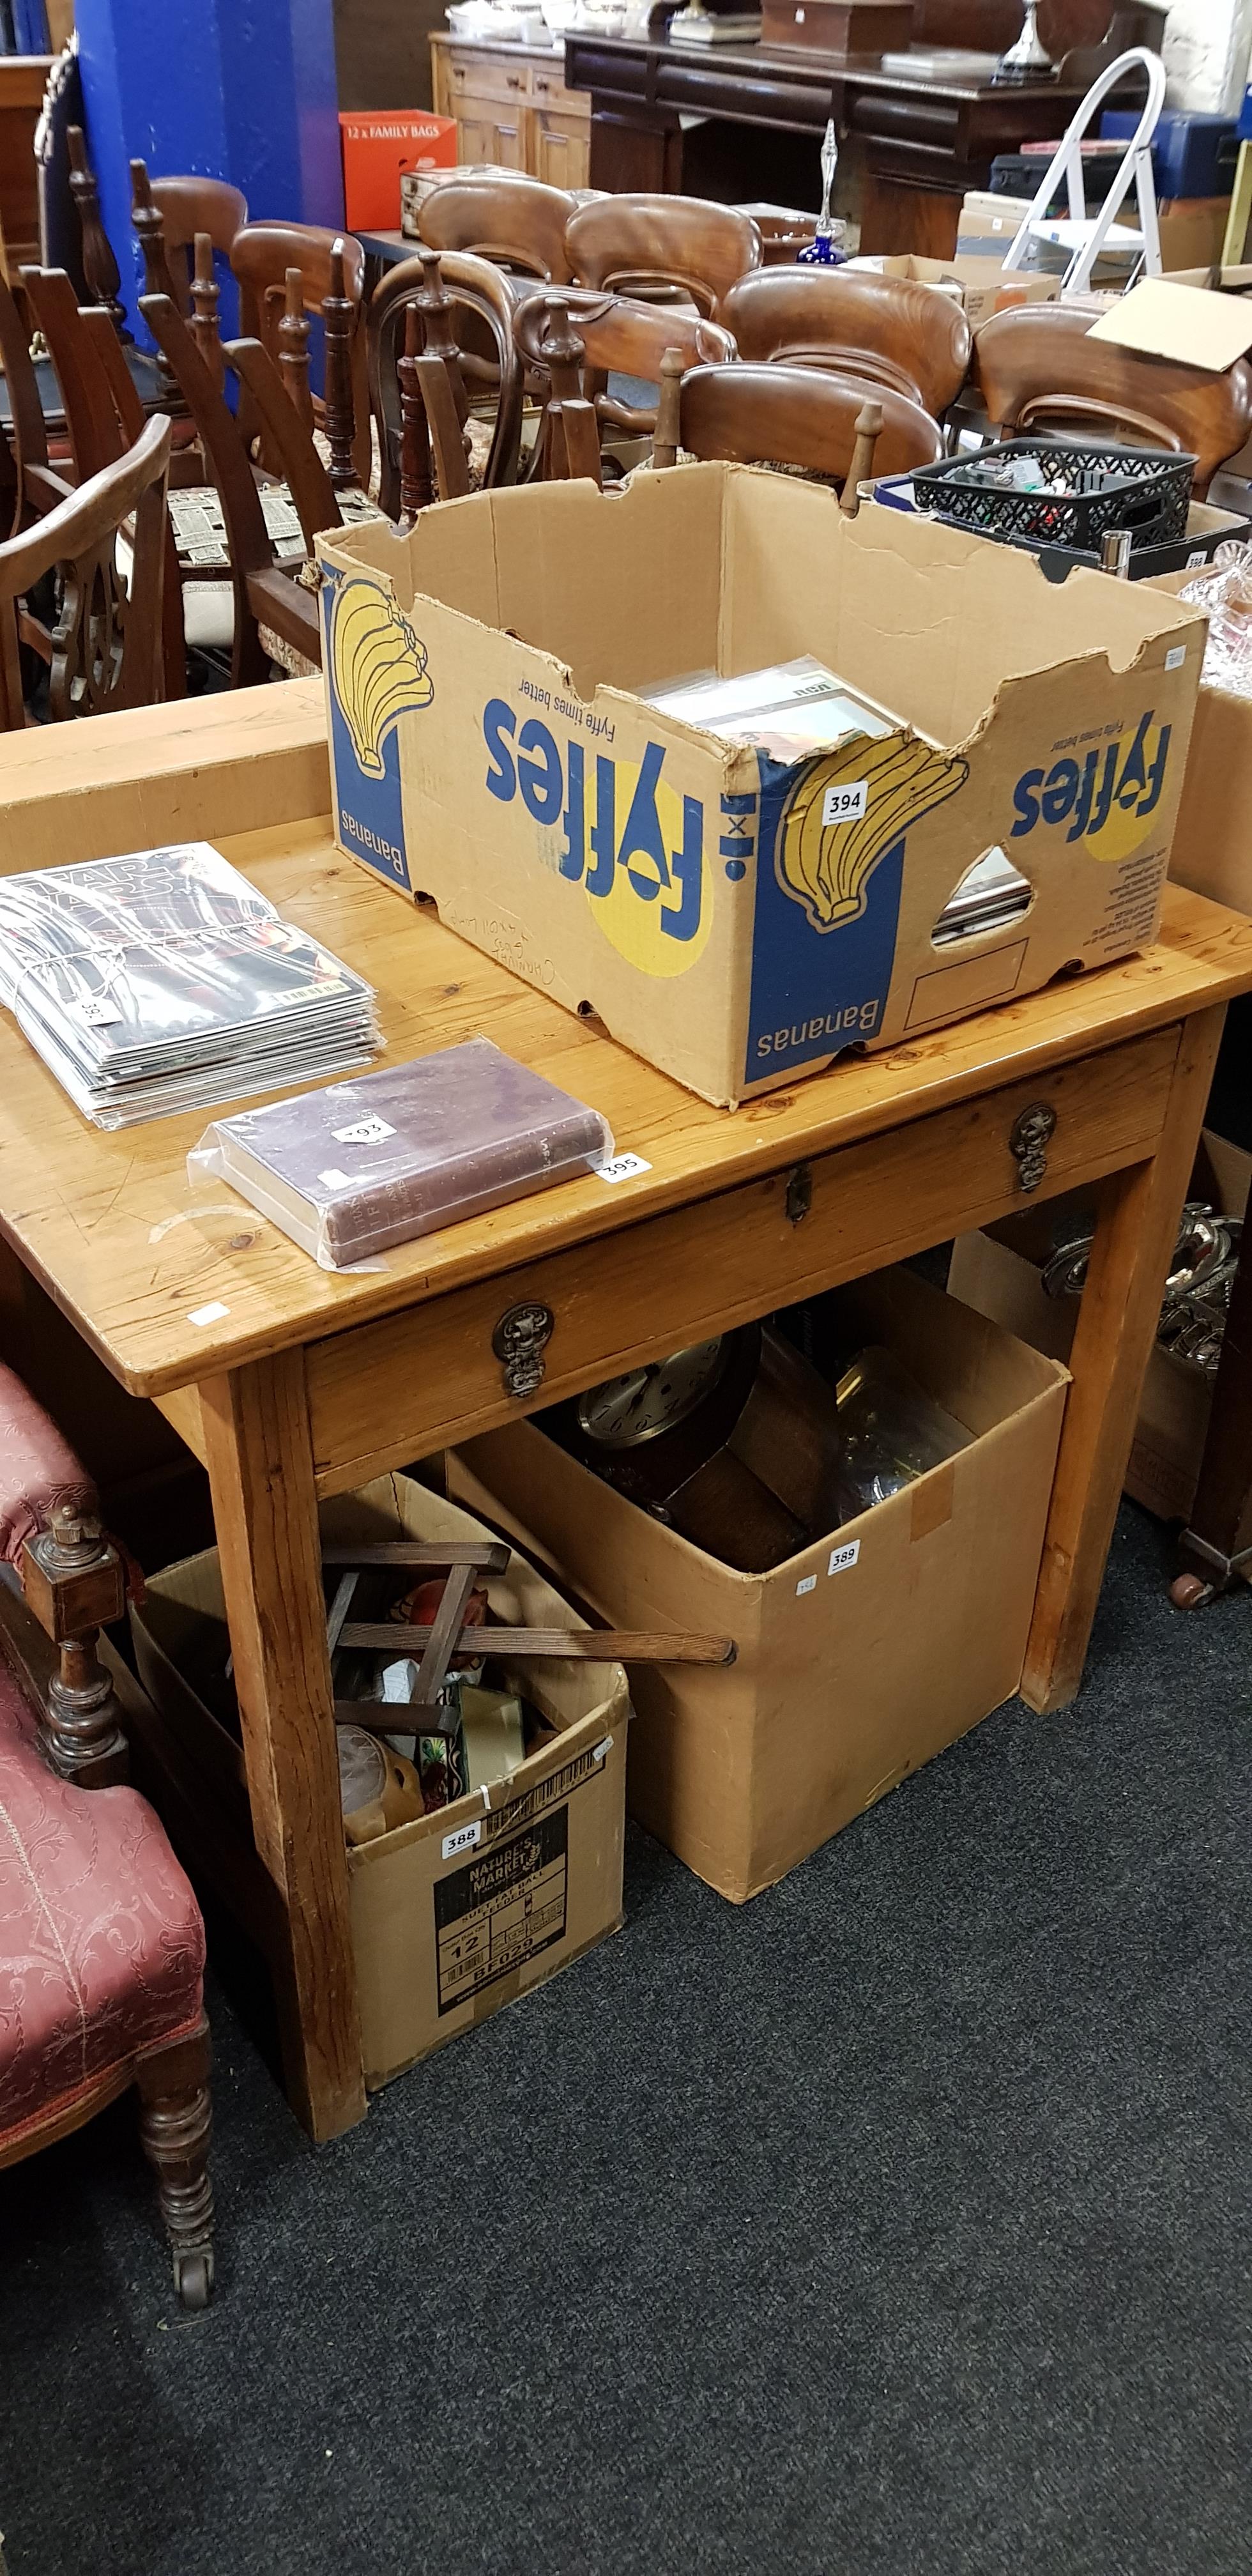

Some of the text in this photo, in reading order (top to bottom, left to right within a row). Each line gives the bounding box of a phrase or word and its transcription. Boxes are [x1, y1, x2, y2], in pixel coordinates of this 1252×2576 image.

[347, 126, 358, 139] 12
[370, 126, 408, 137] FAMILY
[411, 125, 439, 137] BAGS
[518, 678, 615, 743] Fyffe times better
[829, 792, 860, 813] 394
[342, 810, 404, 877] Bananas
[757, 999, 880, 1057] Bananas
[603, 1158, 637, 1176] 395
[833, 1548, 855, 1567] 389
[448, 1829, 475, 1850] 388
[470, 1837, 531, 1882] NATURE'S
[473, 1853, 526, 1893] MARKET
[462, 1902, 491, 1923] SUET
[482, 1888, 525, 1917] FEEDER
[451, 1936, 479, 1959] 12
[474, 1938, 533, 1981] BF029
